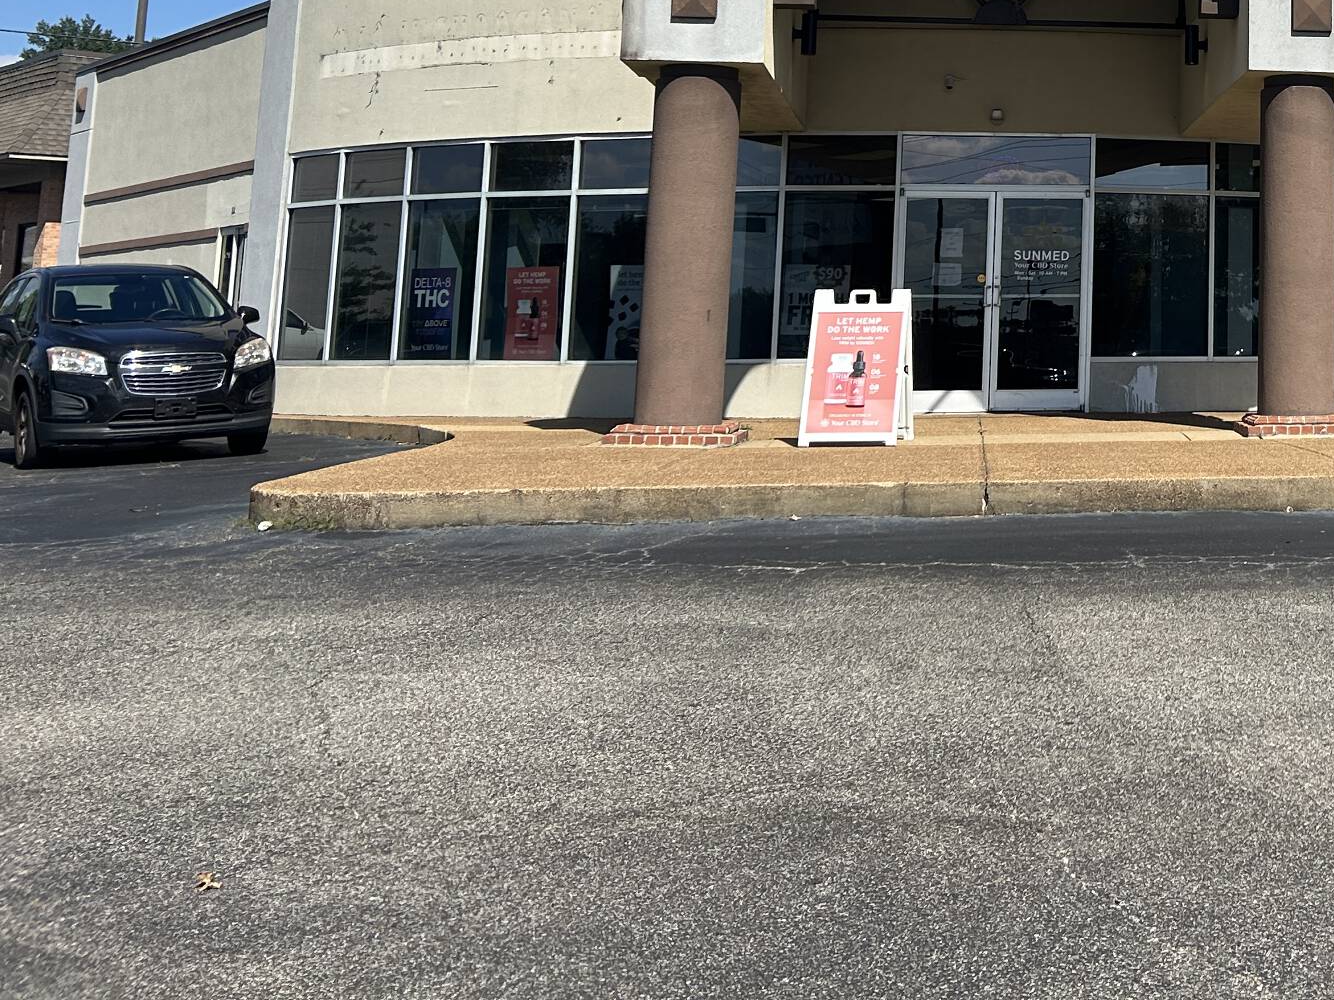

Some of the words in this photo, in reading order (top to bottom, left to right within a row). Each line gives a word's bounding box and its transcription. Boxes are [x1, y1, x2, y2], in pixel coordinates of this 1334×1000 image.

[1014, 250, 1070, 261] SUNMED
[818, 267, 842, 280] $90
[414, 276, 452, 289] DELTA-8
[414, 288, 450, 308] THC
[424, 319, 449, 328] ABOVE
[836, 317, 853, 326] LET
[855, 317, 882, 326] HEMP
[827, 325, 842, 334] DO
[843, 325, 861, 334] THE
[862, 325, 890, 334] WORK
